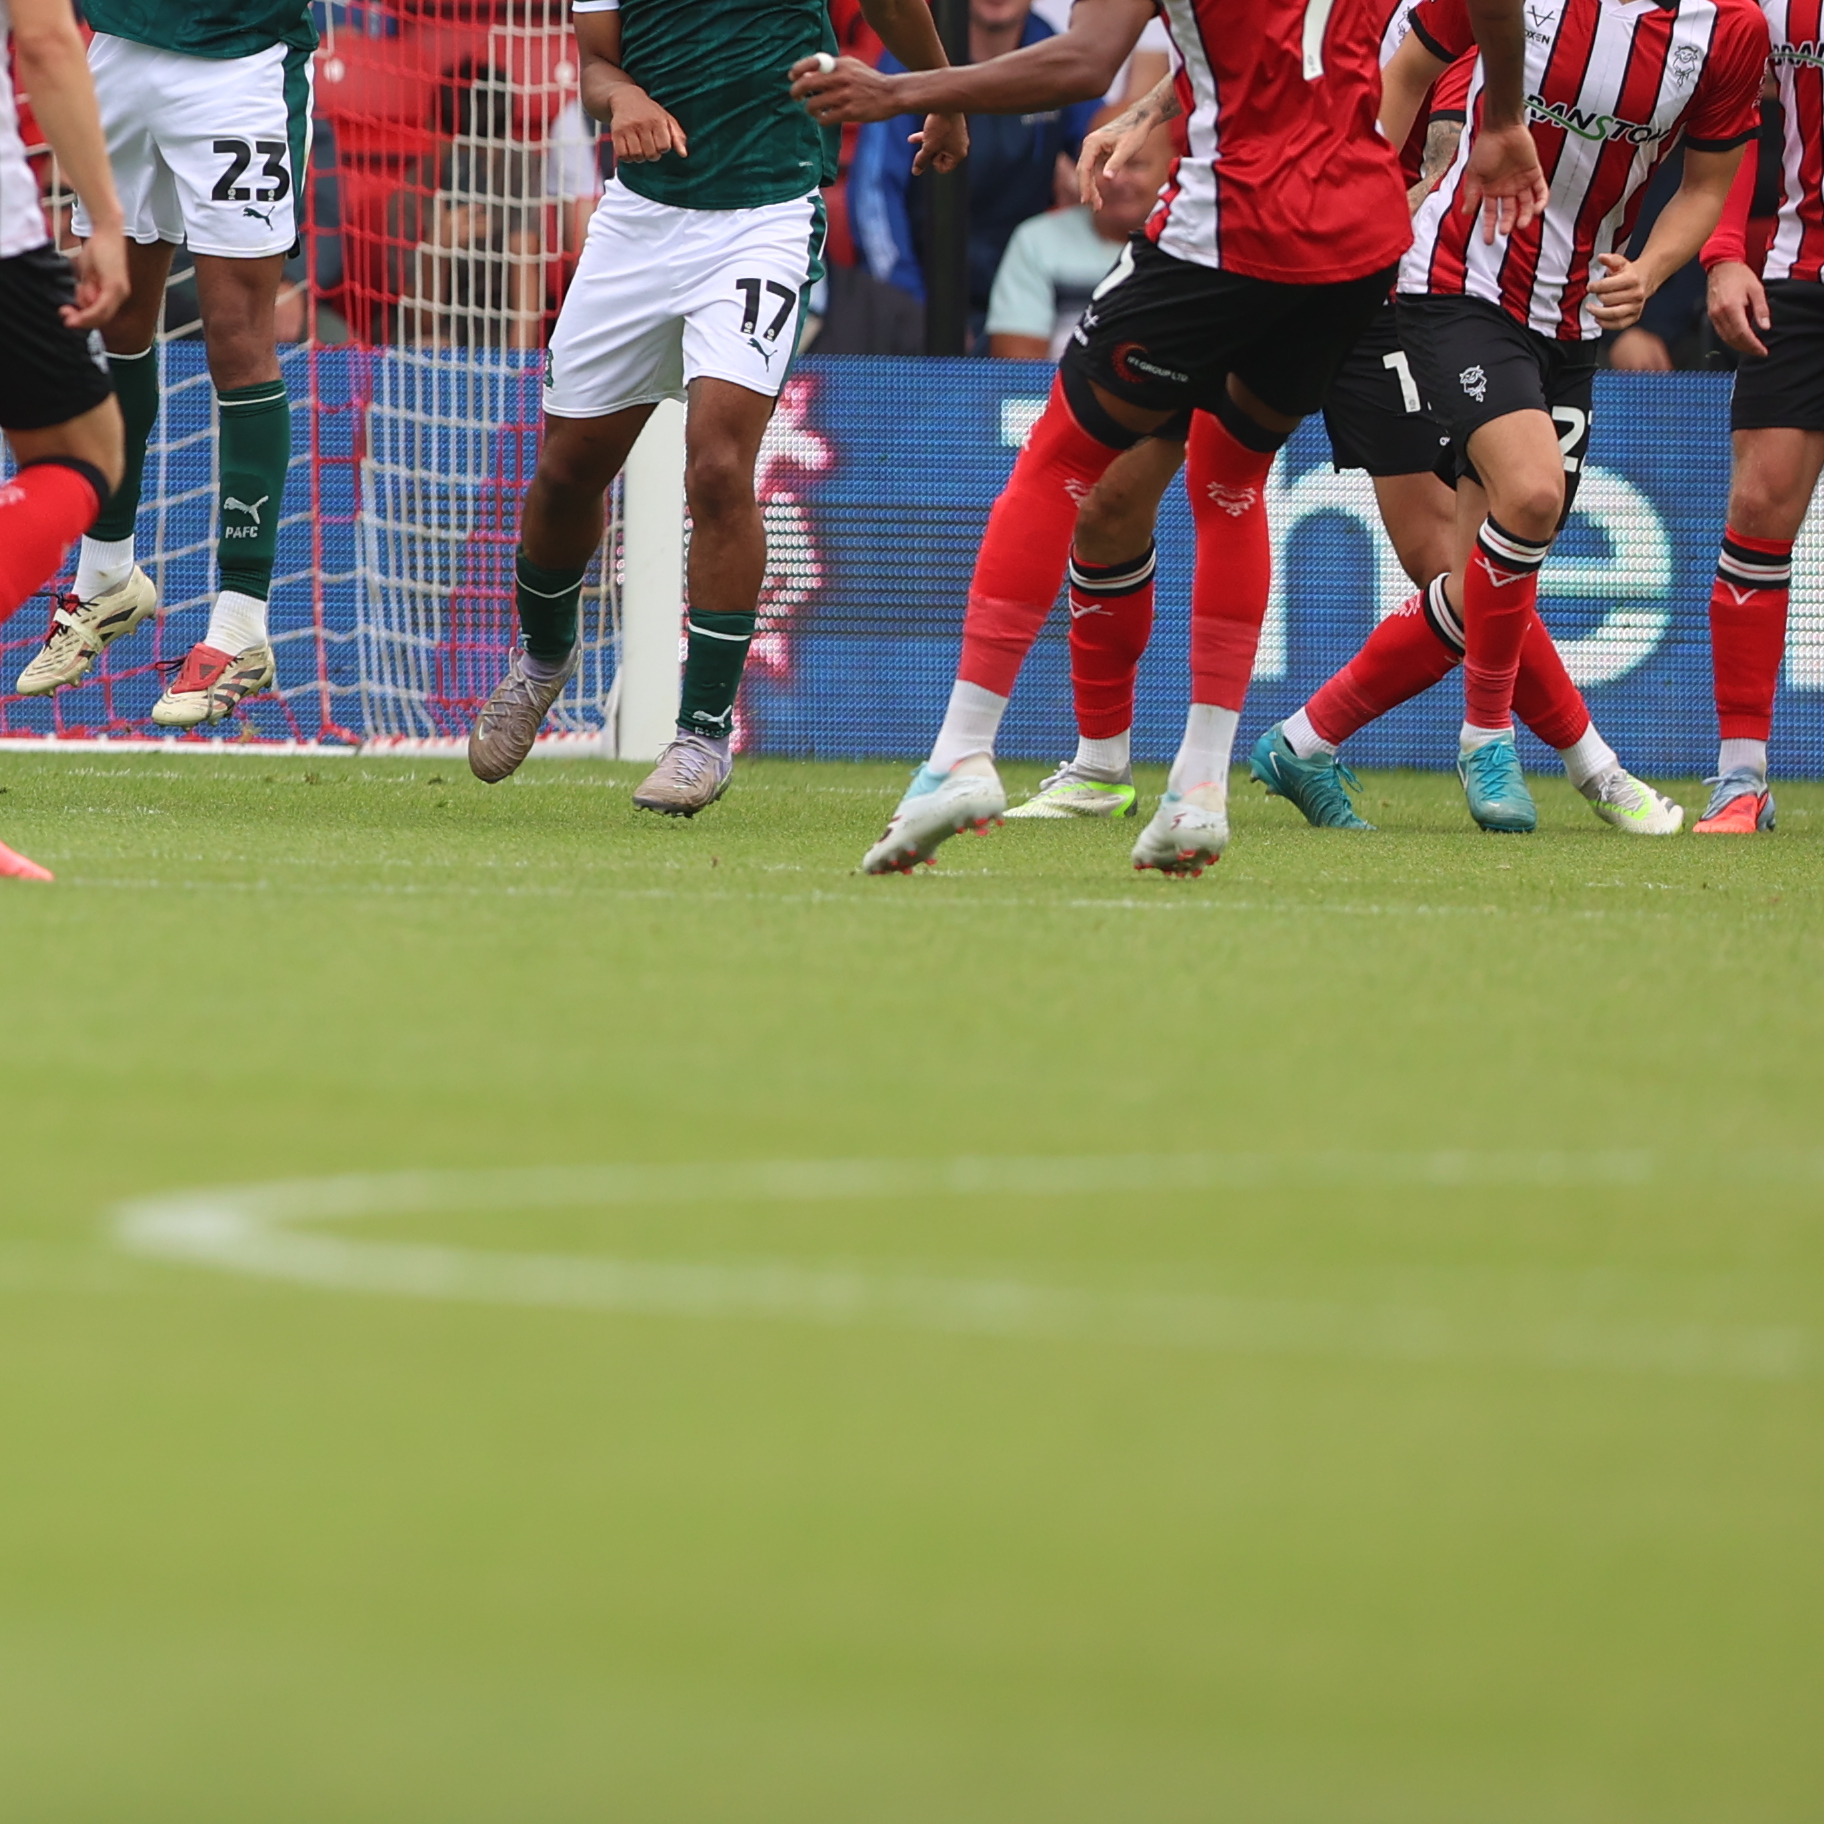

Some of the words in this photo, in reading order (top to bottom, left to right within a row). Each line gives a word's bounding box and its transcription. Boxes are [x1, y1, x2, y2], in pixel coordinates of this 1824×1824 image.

[210, 139, 291, 203] 23
[735, 278, 797, 342] 17
[1552, 405, 1592, 473] 2
[225, 525, 259, 539] PAFC
